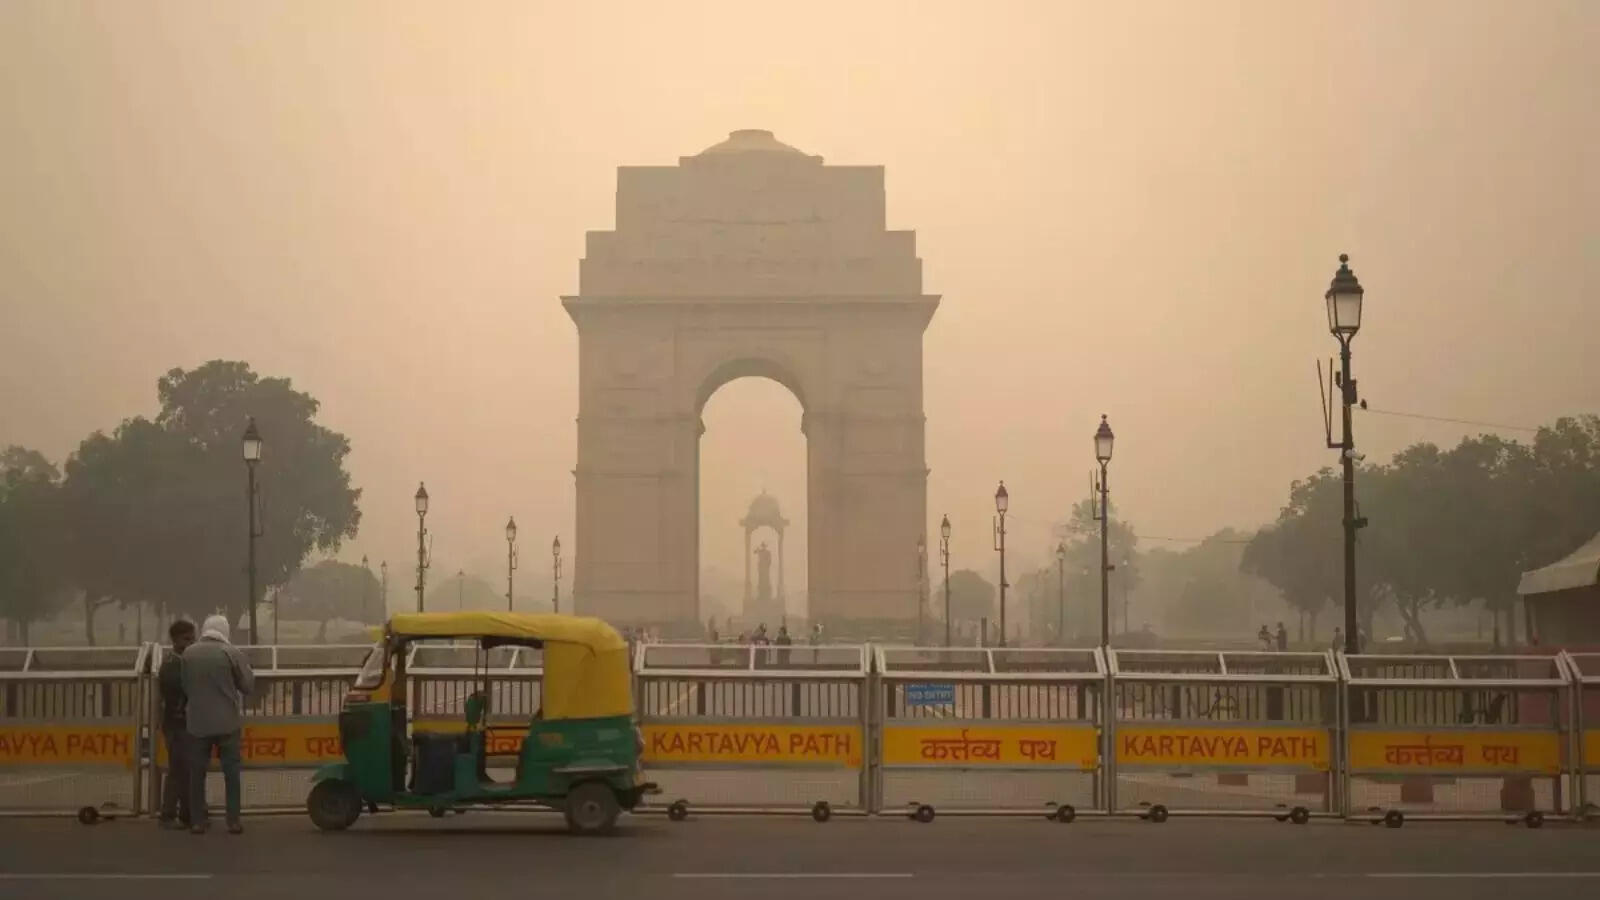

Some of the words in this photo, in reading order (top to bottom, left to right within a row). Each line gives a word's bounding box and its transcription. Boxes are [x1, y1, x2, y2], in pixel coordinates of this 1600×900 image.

[67, 734, 128, 756] PATH
[651, 733, 781, 755] KARTAVYA
[789, 733, 850, 756] PATH
[1019, 739, 1057, 760] पथ
[1124, 735, 1249, 757] KARTAVYA
[1258, 736, 1317, 758] PATH
[1483, 744, 1519, 764] पथ
